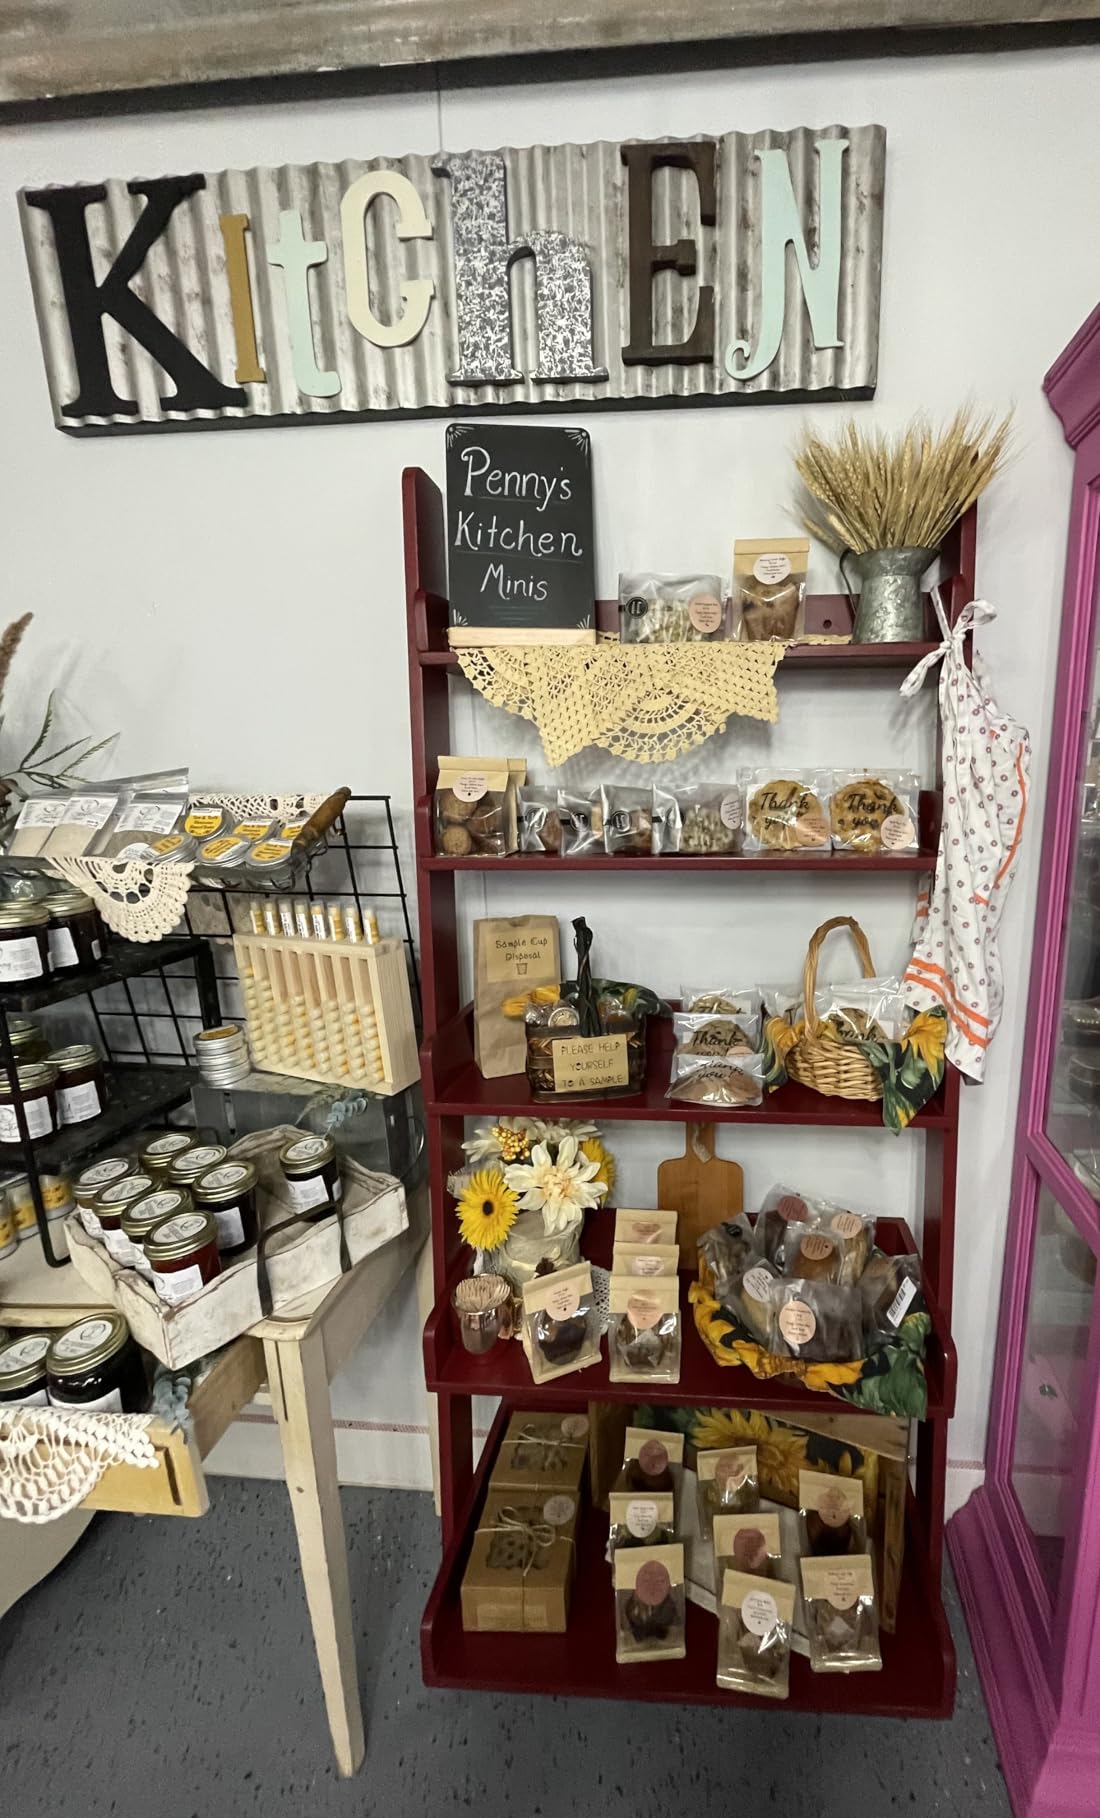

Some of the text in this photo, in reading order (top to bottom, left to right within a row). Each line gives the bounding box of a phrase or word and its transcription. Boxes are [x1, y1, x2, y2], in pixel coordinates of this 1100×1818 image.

[460, 446, 572, 512] Penny's
[454, 510, 583, 558] Kitchen
[480, 563, 548, 601] Minis
[760, 791, 810, 811] Thank
[847, 792, 897, 815] Thank
[495, 936, 548, 949] Sample Cup
[692, 1030, 744, 1047] Thank
[561, 1041, 621, 1056] PLEASE HELP
[570, 1058, 614, 1071] YOURSELF
[562, 1074, 623, 1088] TO A SAMPLE
